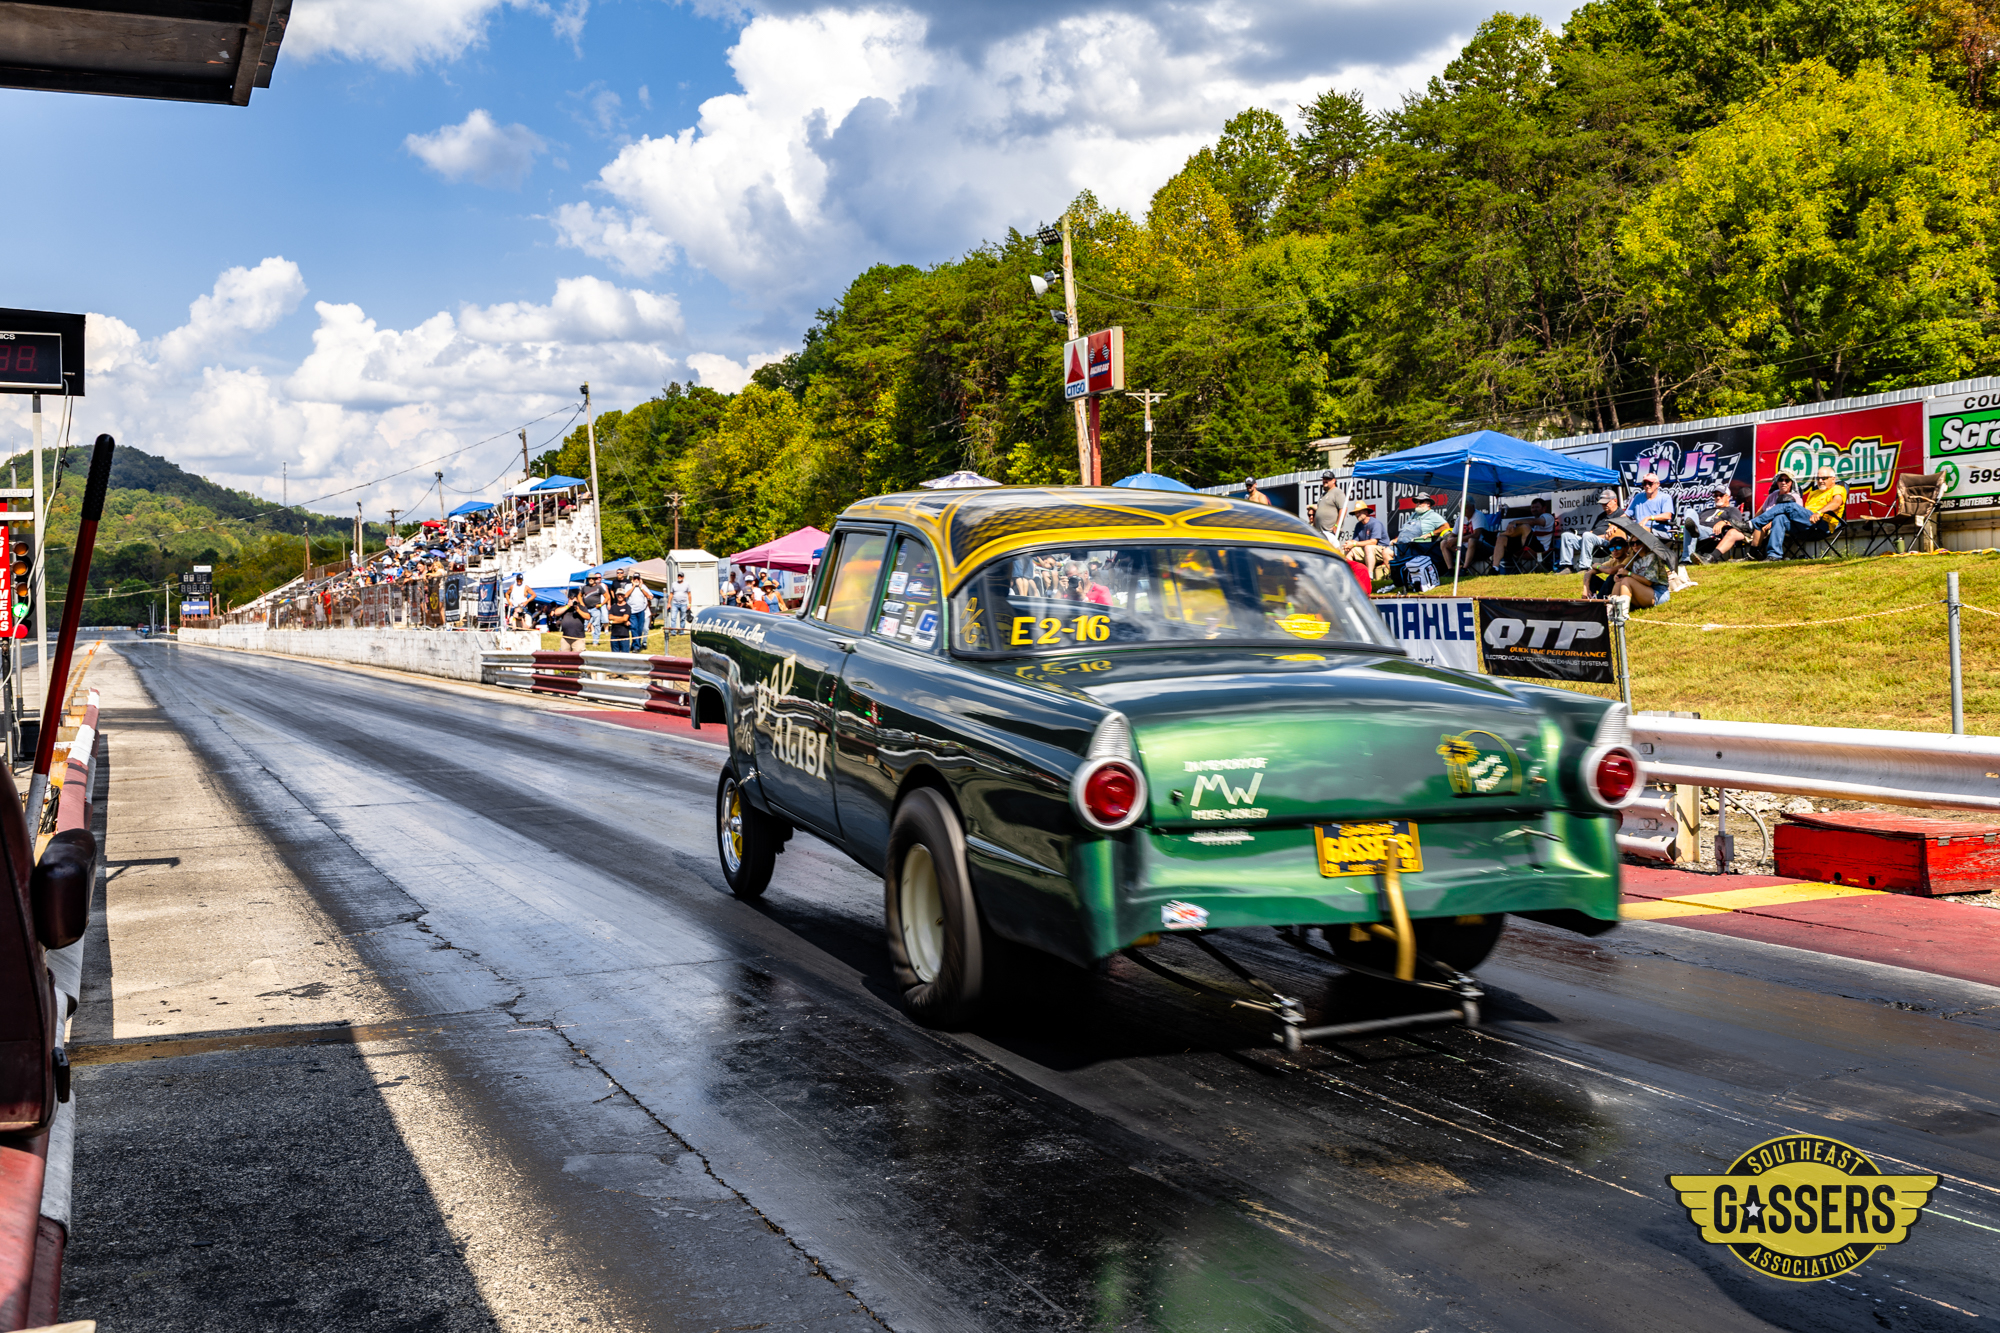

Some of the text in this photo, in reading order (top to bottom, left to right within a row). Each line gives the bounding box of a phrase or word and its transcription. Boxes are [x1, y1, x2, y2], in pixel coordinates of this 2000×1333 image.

[1066, 381, 1085, 396] CITGO
[1783, 441, 1893, 486] O'Reilly
[1559, 496, 1580, 509] Since
[1959, 496, 1994, 508] BATTERIES
[1010, 615, 1110, 646] E2-16
[1483, 617, 1604, 650] QTP
[1485, 653, 1526, 662] ELECTRONICALLY
[1510, 646, 1529, 654] QUICK
[1546, 649, 1607, 658] PERFORMANCE
[1190, 772, 1264, 807] MW
[1322, 833, 1415, 863] GASSES
